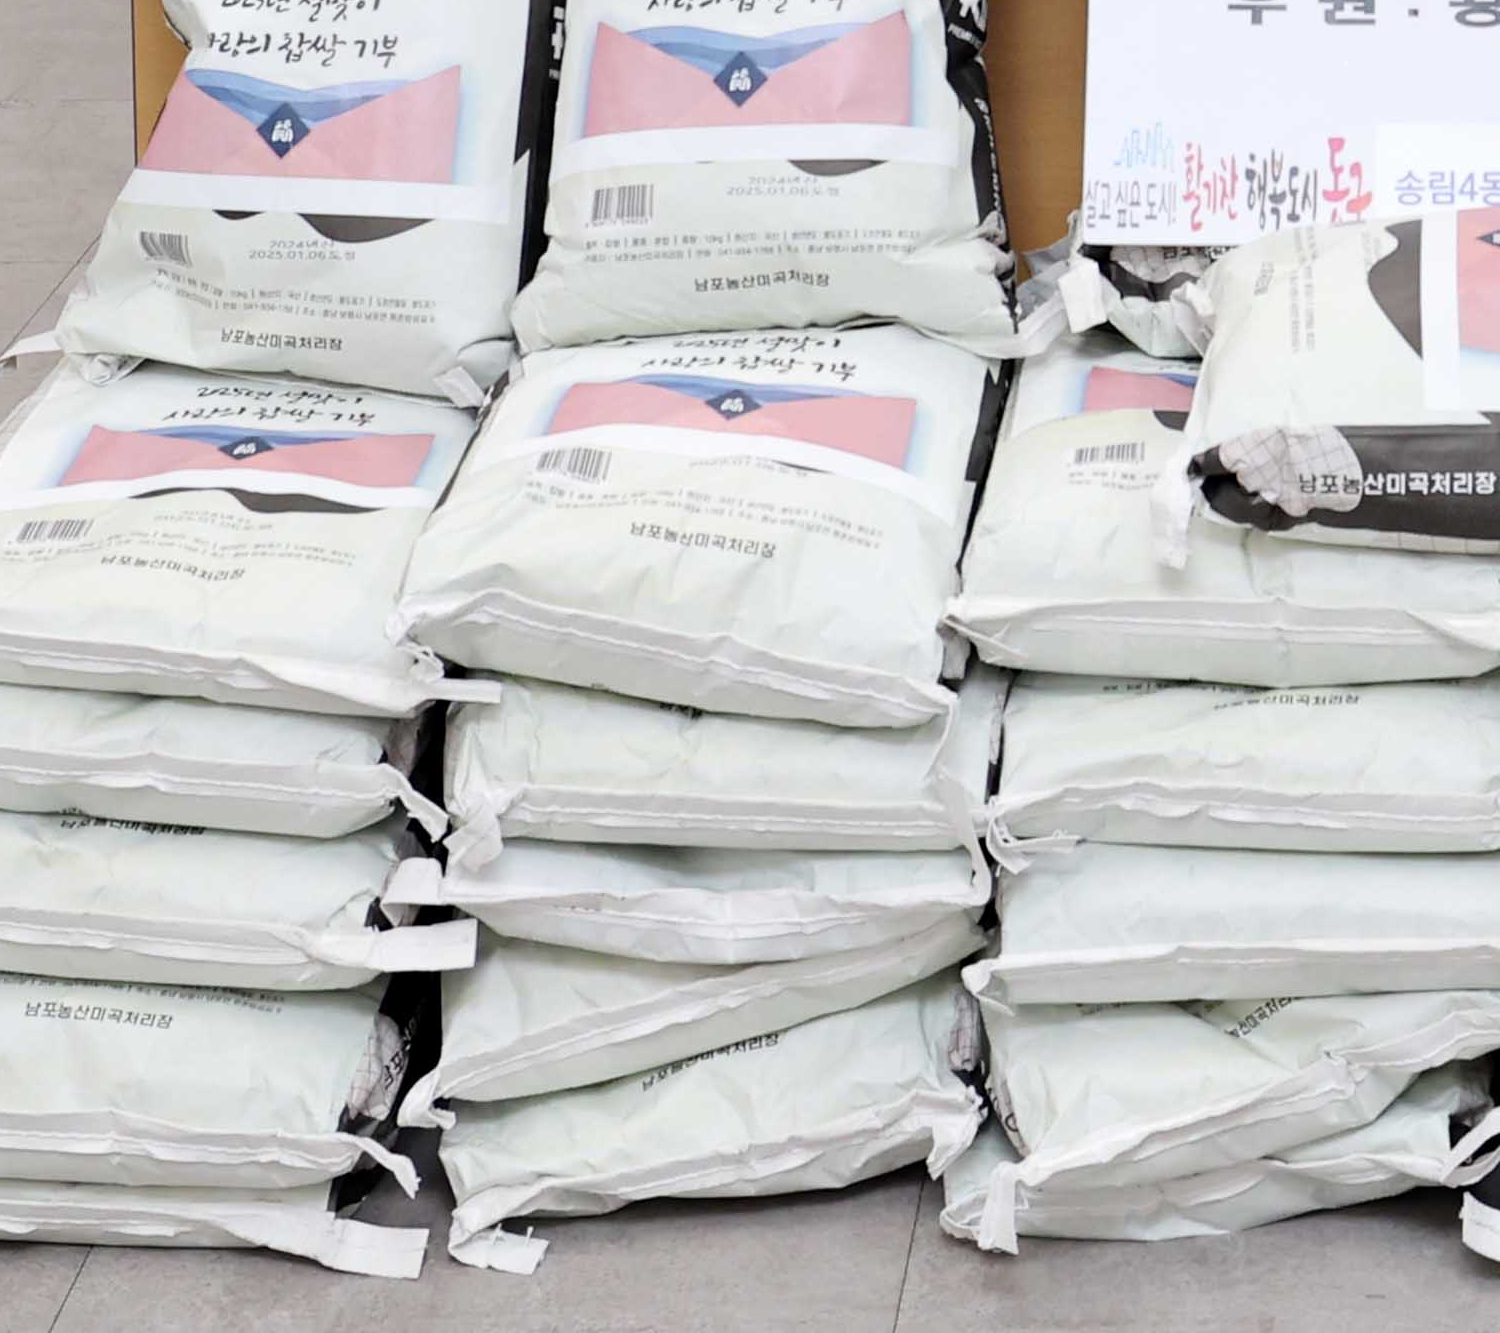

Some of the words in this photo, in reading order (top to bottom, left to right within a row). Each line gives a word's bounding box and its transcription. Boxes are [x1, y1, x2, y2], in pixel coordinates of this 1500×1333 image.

[206, 31, 272, 58] 랑의
[277, 31, 347, 67] 찹쌀
[353, 34, 398, 68] 기부
[694, 269, 830, 292] 남포농산미곡처리장
[221, 328, 343, 352] 남포농산미곡처리장
[1300, 470, 1495, 498] 남포농산미곡처리장
[630, 522, 777, 560] 남포농산미곡처리장
[24, 1001, 173, 1030] 남포농산미곡처리장
